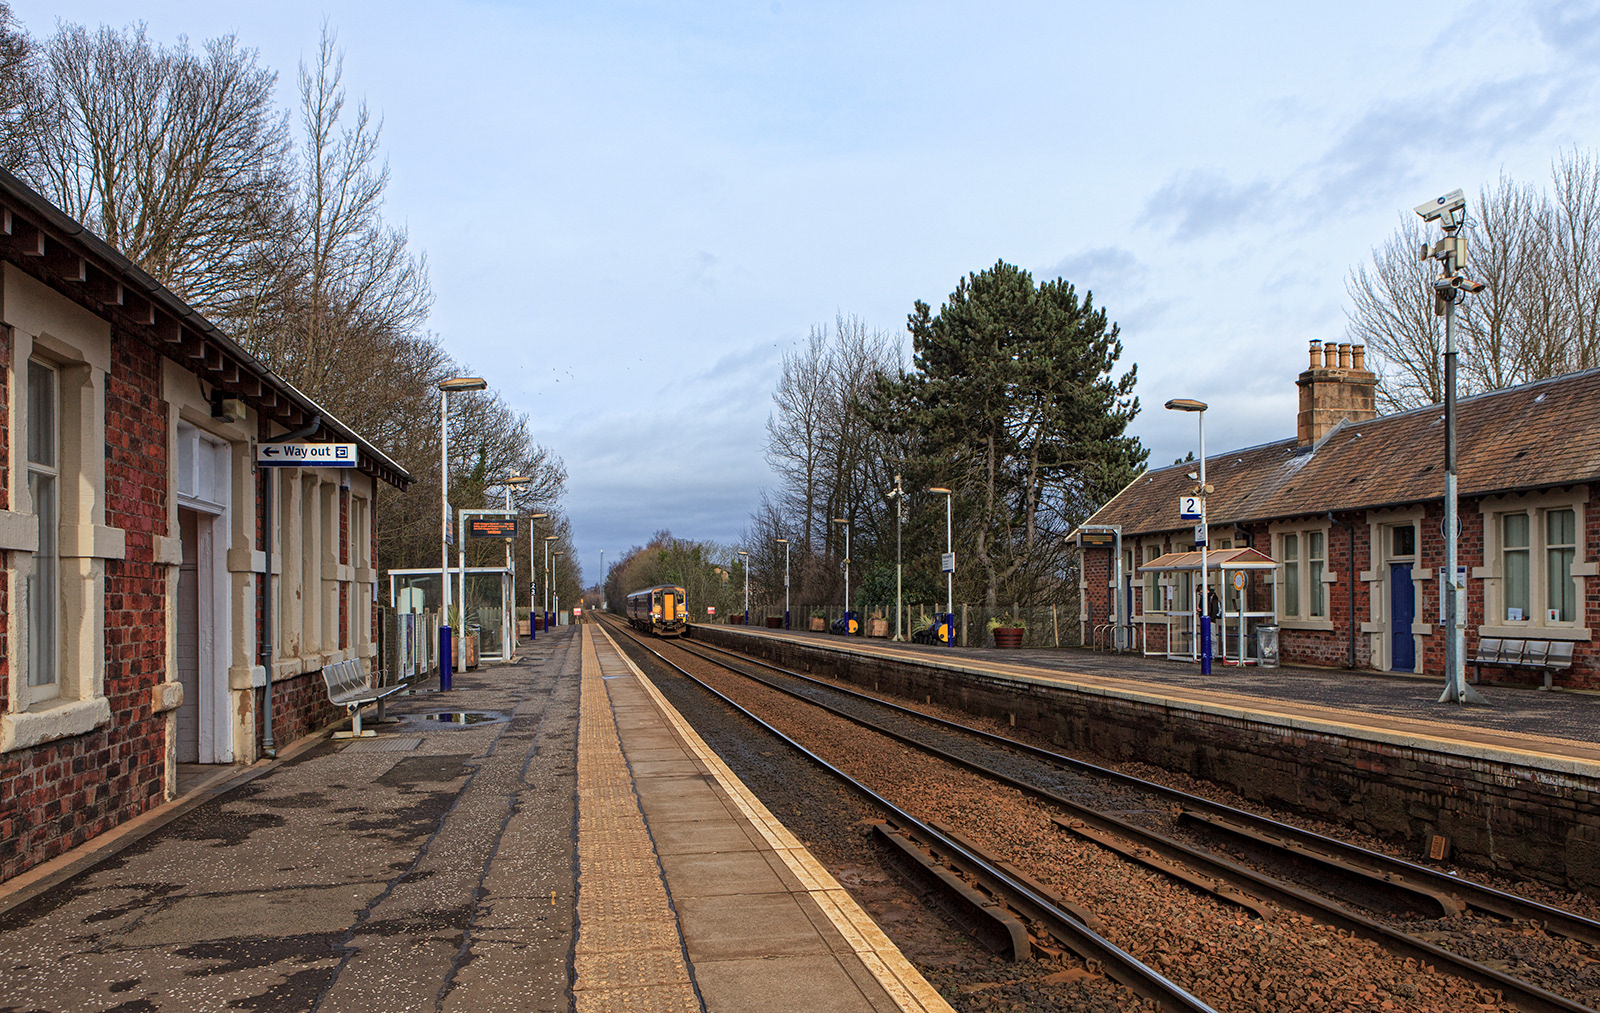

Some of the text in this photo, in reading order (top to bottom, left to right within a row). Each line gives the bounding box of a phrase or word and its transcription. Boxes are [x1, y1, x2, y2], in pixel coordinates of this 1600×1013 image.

[283, 445, 331, 459] Way out
[1186, 498, 1195, 513] 2
